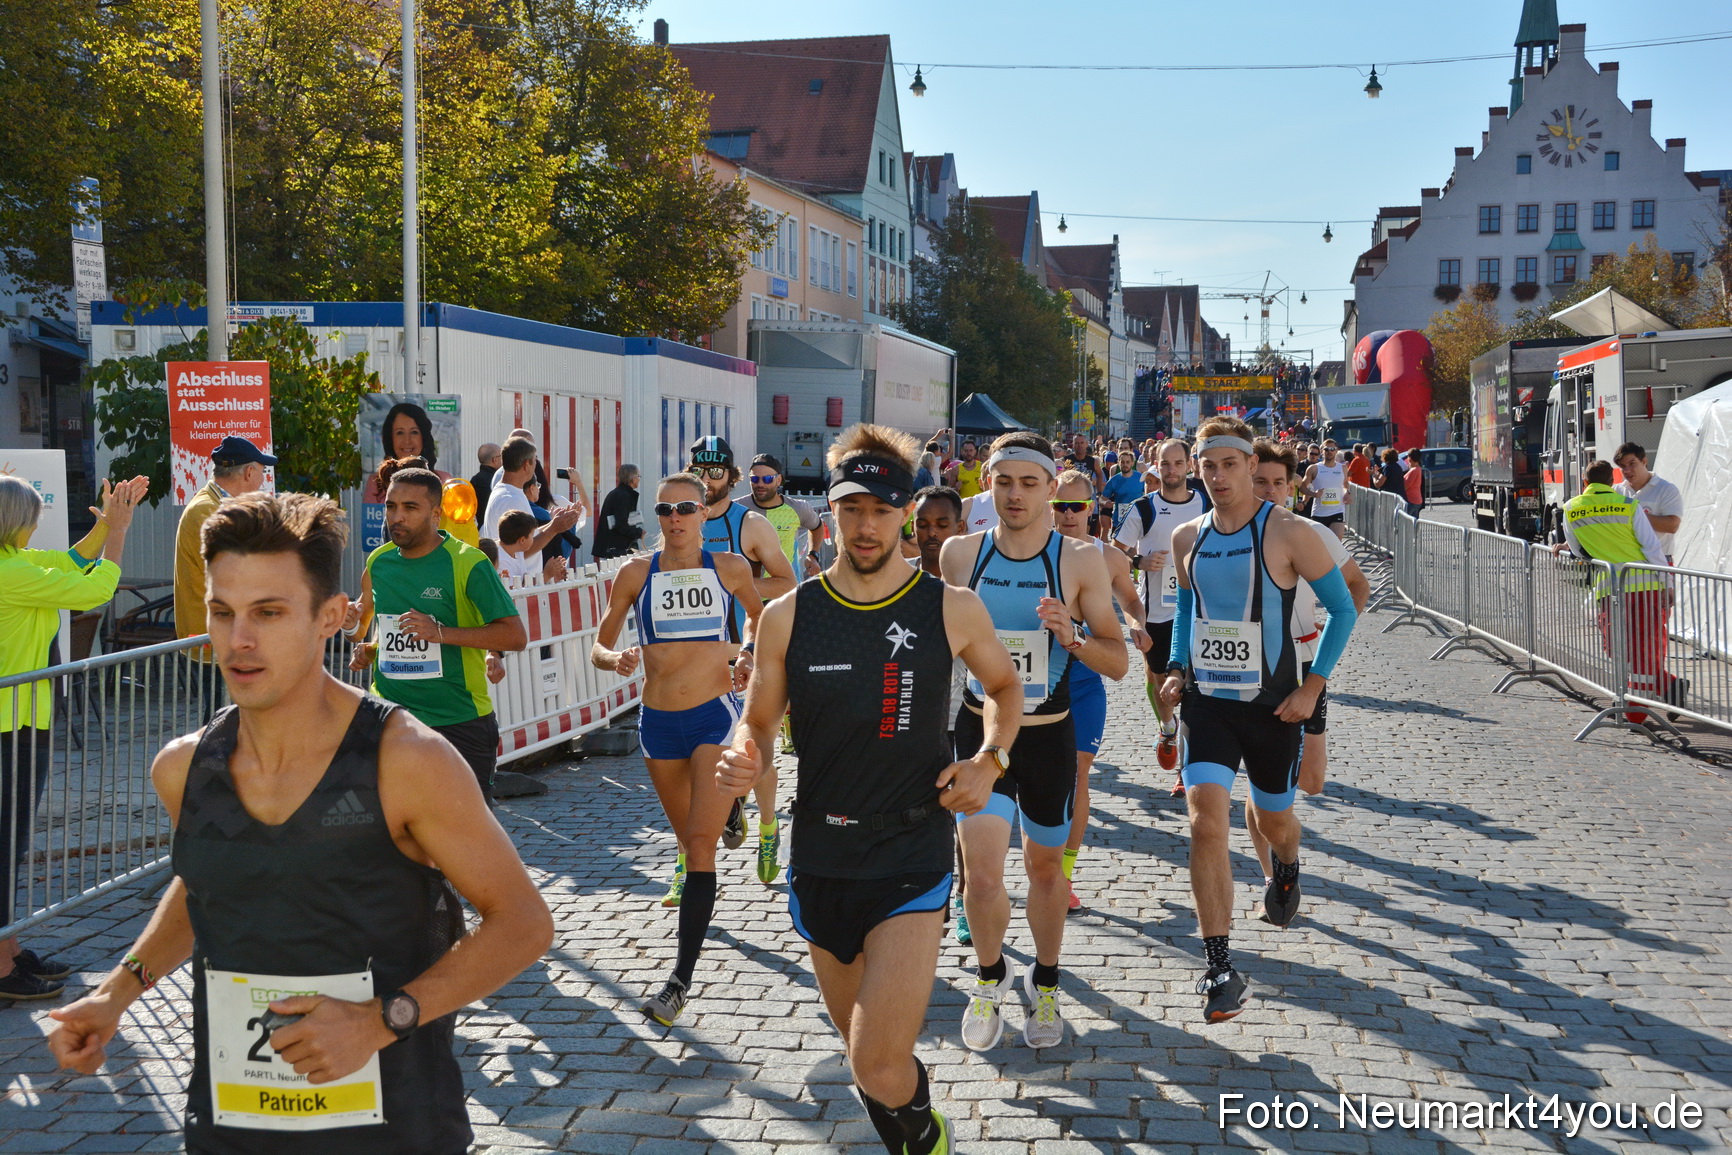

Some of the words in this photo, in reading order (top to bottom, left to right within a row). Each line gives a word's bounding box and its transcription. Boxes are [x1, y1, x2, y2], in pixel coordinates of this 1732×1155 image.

[76, 256, 103, 267] Parkschein
[79, 267, 102, 279] werktags
[176, 371, 263, 386] Abschluss
[1204, 379, 1241, 388] START
[176, 388, 206, 397] statt
[177, 398, 265, 411] Ausschluss!
[193, 420, 218, 429] Mehr
[219, 419, 248, 429] Lehrer
[249, 419, 262, 429] für
[189, 430, 226, 439] kleinere
[227, 430, 262, 439] Klassen.
[696, 451, 728, 464] KULT
[1570, 505, 1626, 519] Org.-Leiter
[671, 574, 703, 585] BOCK
[420, 587, 443, 598] AOK
[661, 586, 713, 610] 3100
[1208, 625, 1240, 636] BOCK
[385, 632, 429, 652] 2640
[1200, 638, 1250, 662] 2393
[390, 663, 425, 673] Soufiane
[1010, 651, 1032, 673] 51
[883, 662, 899, 695] ROTH
[1207, 671, 1242, 683] Thomas
[882, 697, 898, 714] 08
[897, 670, 914, 731] TRIATHLON
[879, 716, 895, 739] TSG
[320, 813, 375, 827] adidas
[243, 1069, 276, 1081] PARTL
[277, 1071, 307, 1083] Neum
[259, 1091, 328, 1112] Patrick
